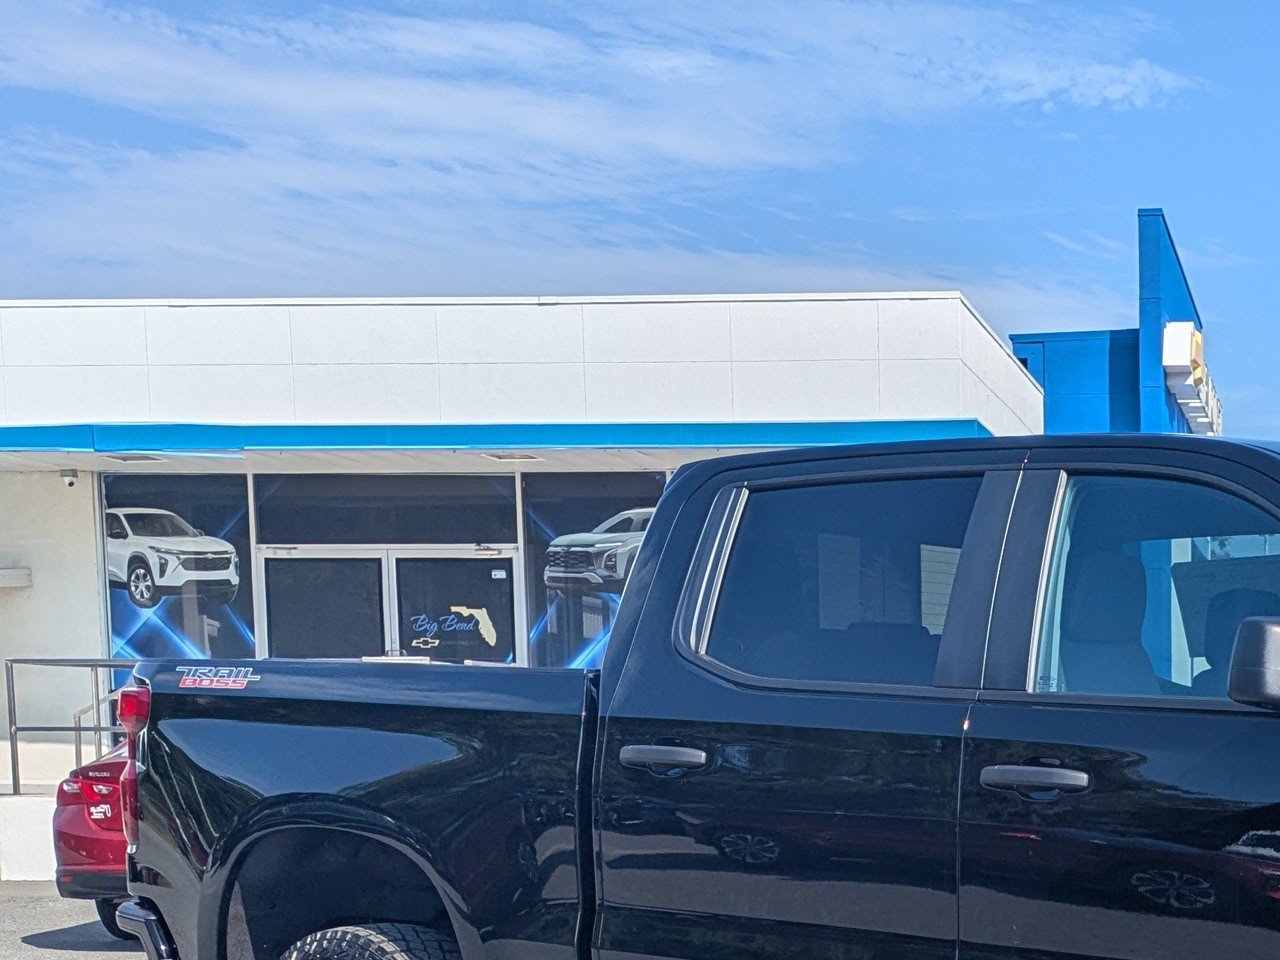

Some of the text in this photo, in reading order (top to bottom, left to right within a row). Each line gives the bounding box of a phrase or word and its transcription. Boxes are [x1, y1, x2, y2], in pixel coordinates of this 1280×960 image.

[410, 613, 477, 637] Big Bend
[175, 665, 261, 681] TRAIL
[179, 677, 248, 690] BOSS
